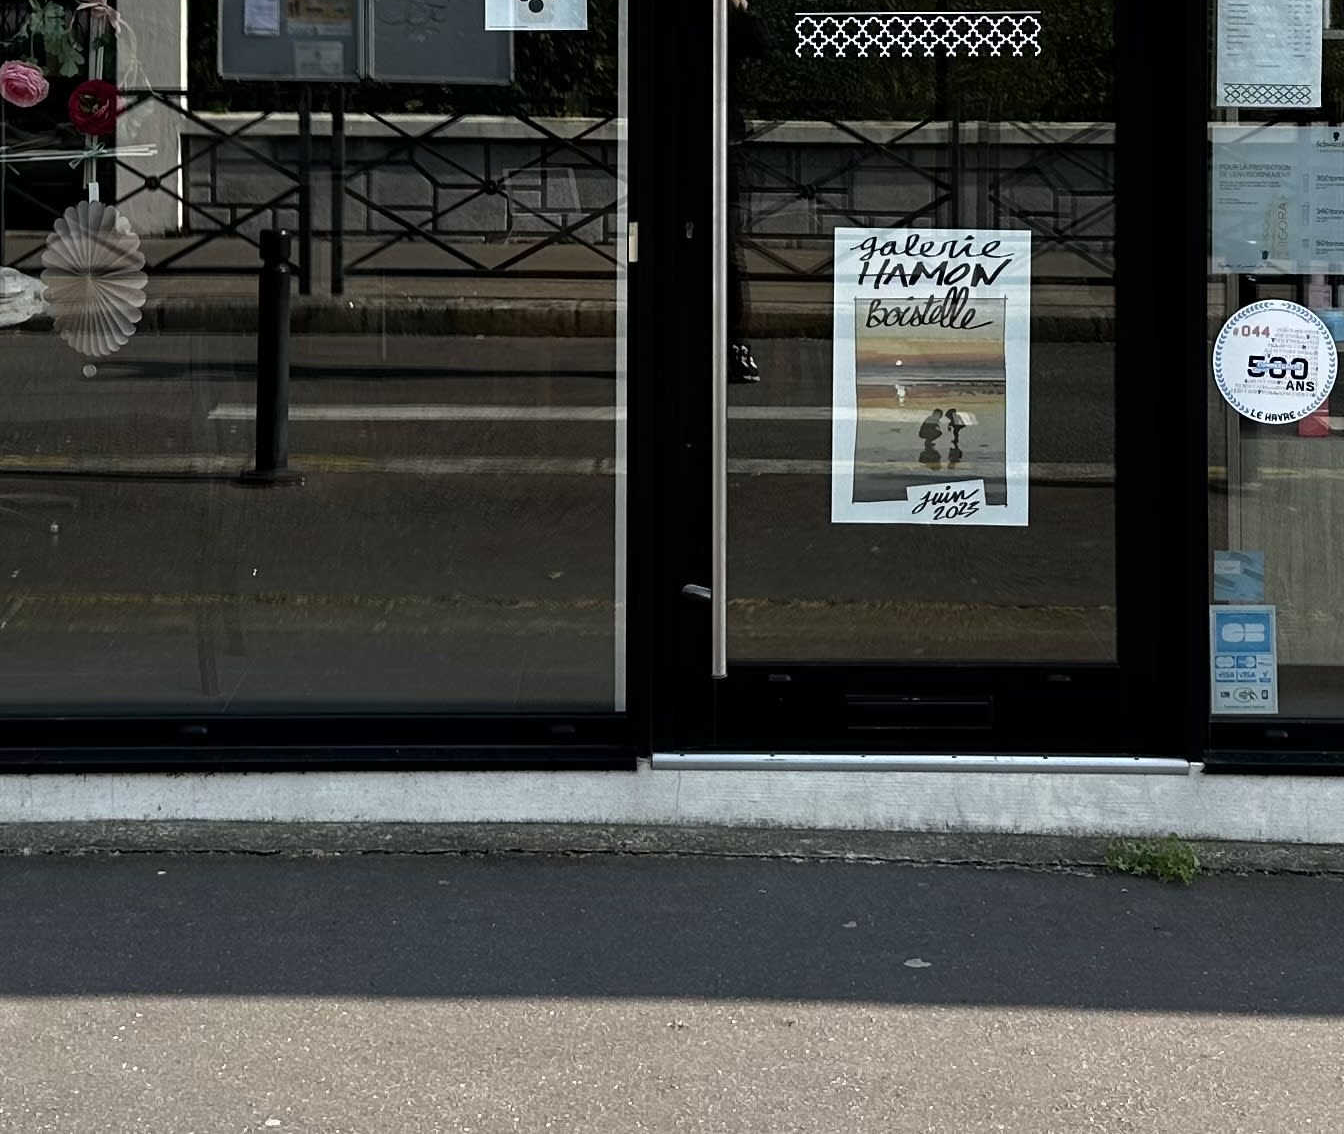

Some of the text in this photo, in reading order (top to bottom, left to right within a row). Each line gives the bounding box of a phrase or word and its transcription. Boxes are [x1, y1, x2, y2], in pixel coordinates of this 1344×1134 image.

[850, 233, 1014, 261] galerie
[858, 258, 1013, 289] HAMON
[1285, 380, 1315, 392] ANS
[911, 485, 980, 514] juin
